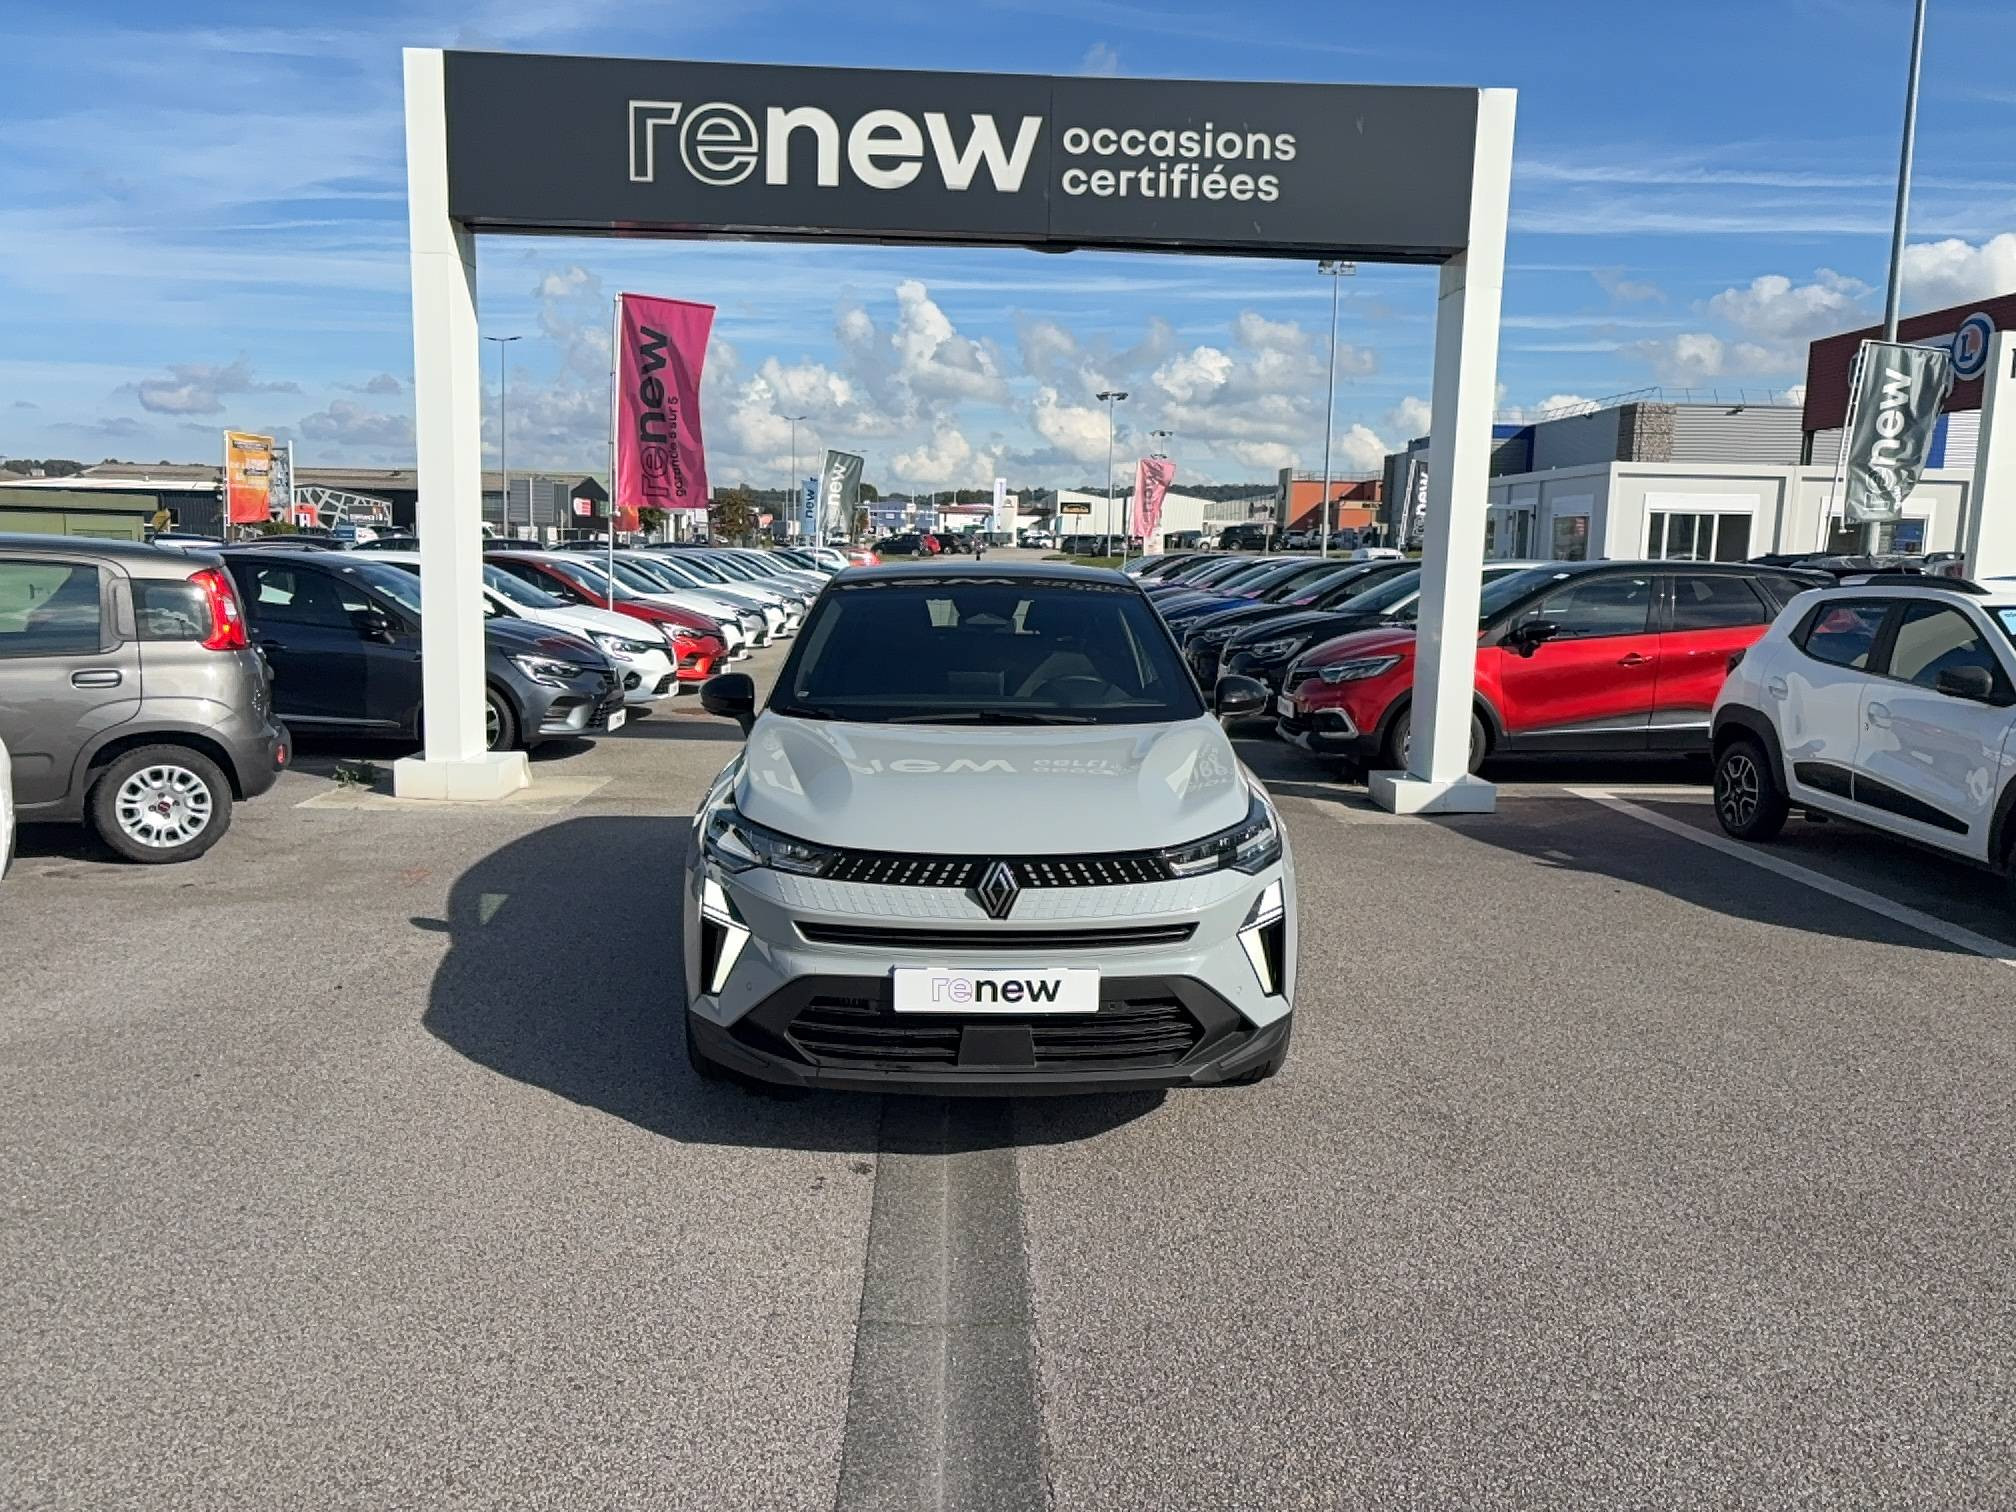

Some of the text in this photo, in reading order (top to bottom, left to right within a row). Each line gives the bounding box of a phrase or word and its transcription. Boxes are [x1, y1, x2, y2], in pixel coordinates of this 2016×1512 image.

[628, 100, 1043, 193] renew
[1062, 122, 1297, 162] occasions
[1061, 164, 1281, 202] certifiées
[640, 326, 671, 497] renew
[1863, 367, 1912, 511] renew
[931, 977, 1062, 1003] renew
